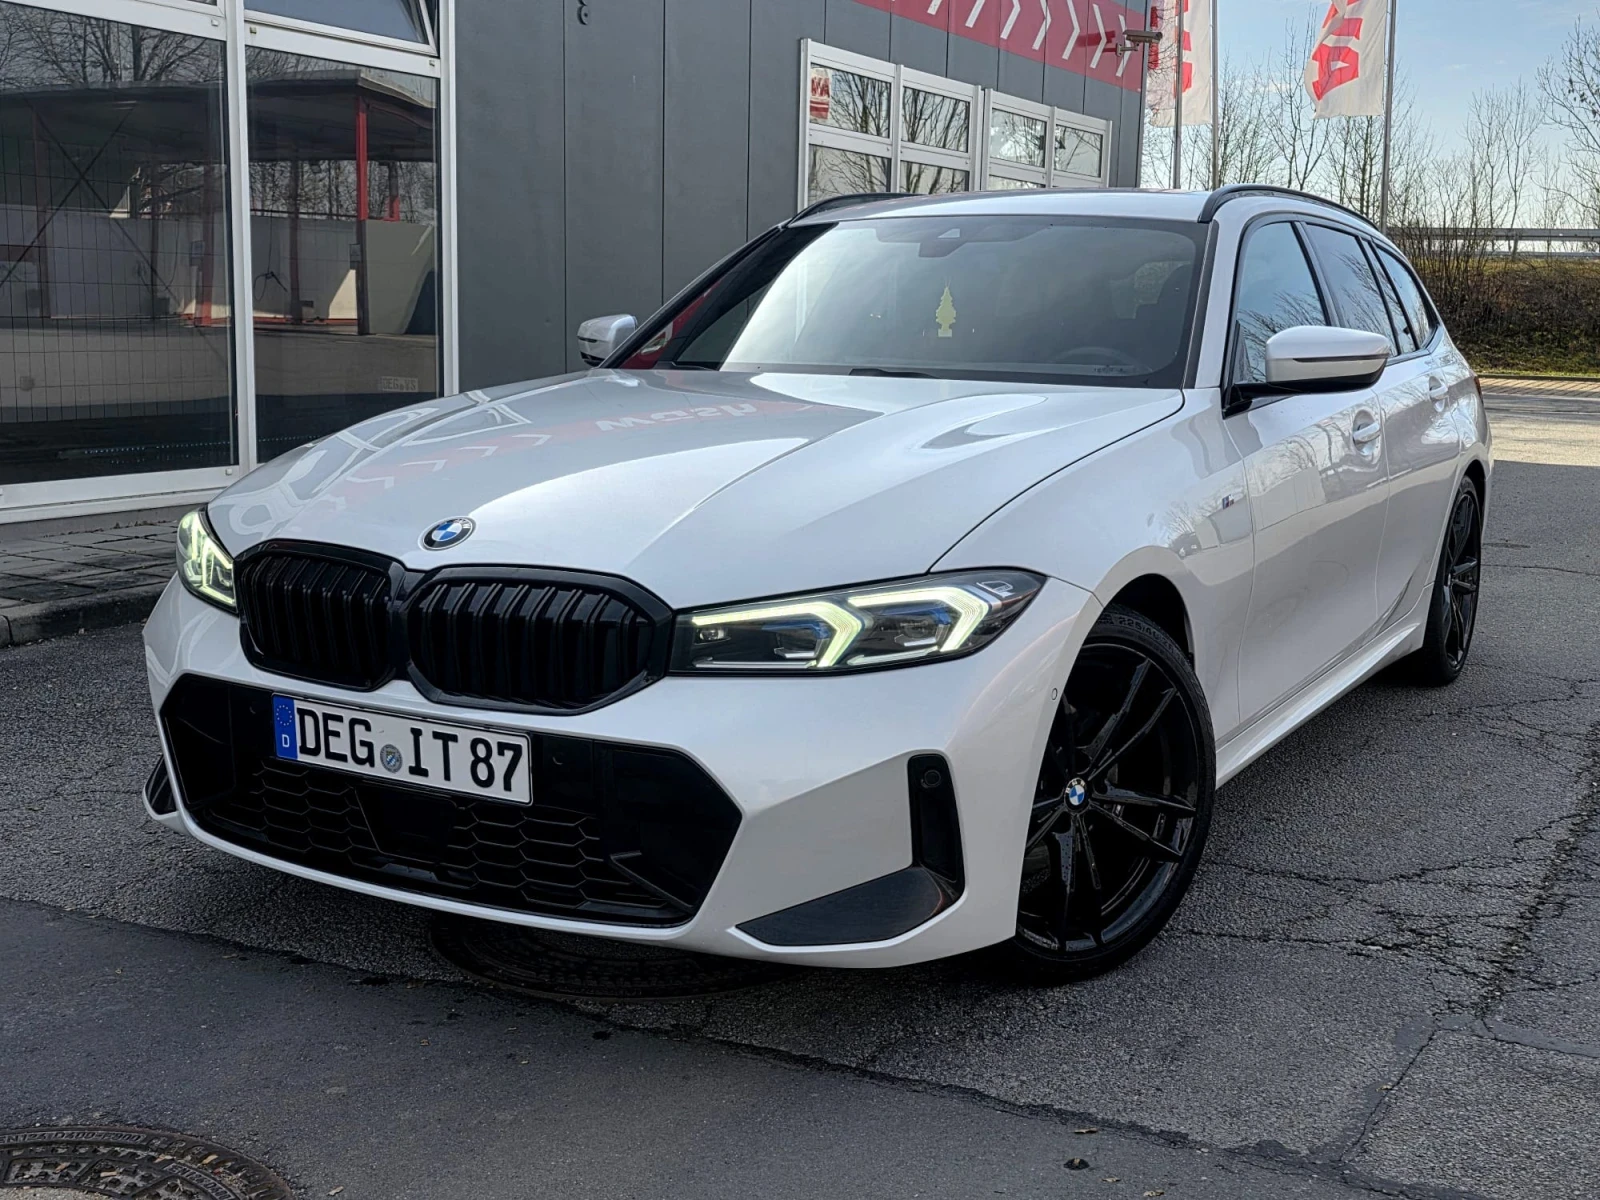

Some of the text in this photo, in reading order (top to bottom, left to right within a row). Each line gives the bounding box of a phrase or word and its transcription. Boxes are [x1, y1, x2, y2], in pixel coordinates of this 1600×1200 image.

[282, 734, 290, 748] D
[296, 707, 375, 768] DEG
[408, 727, 458, 782] IT
[470, 737, 523, 792] 87
